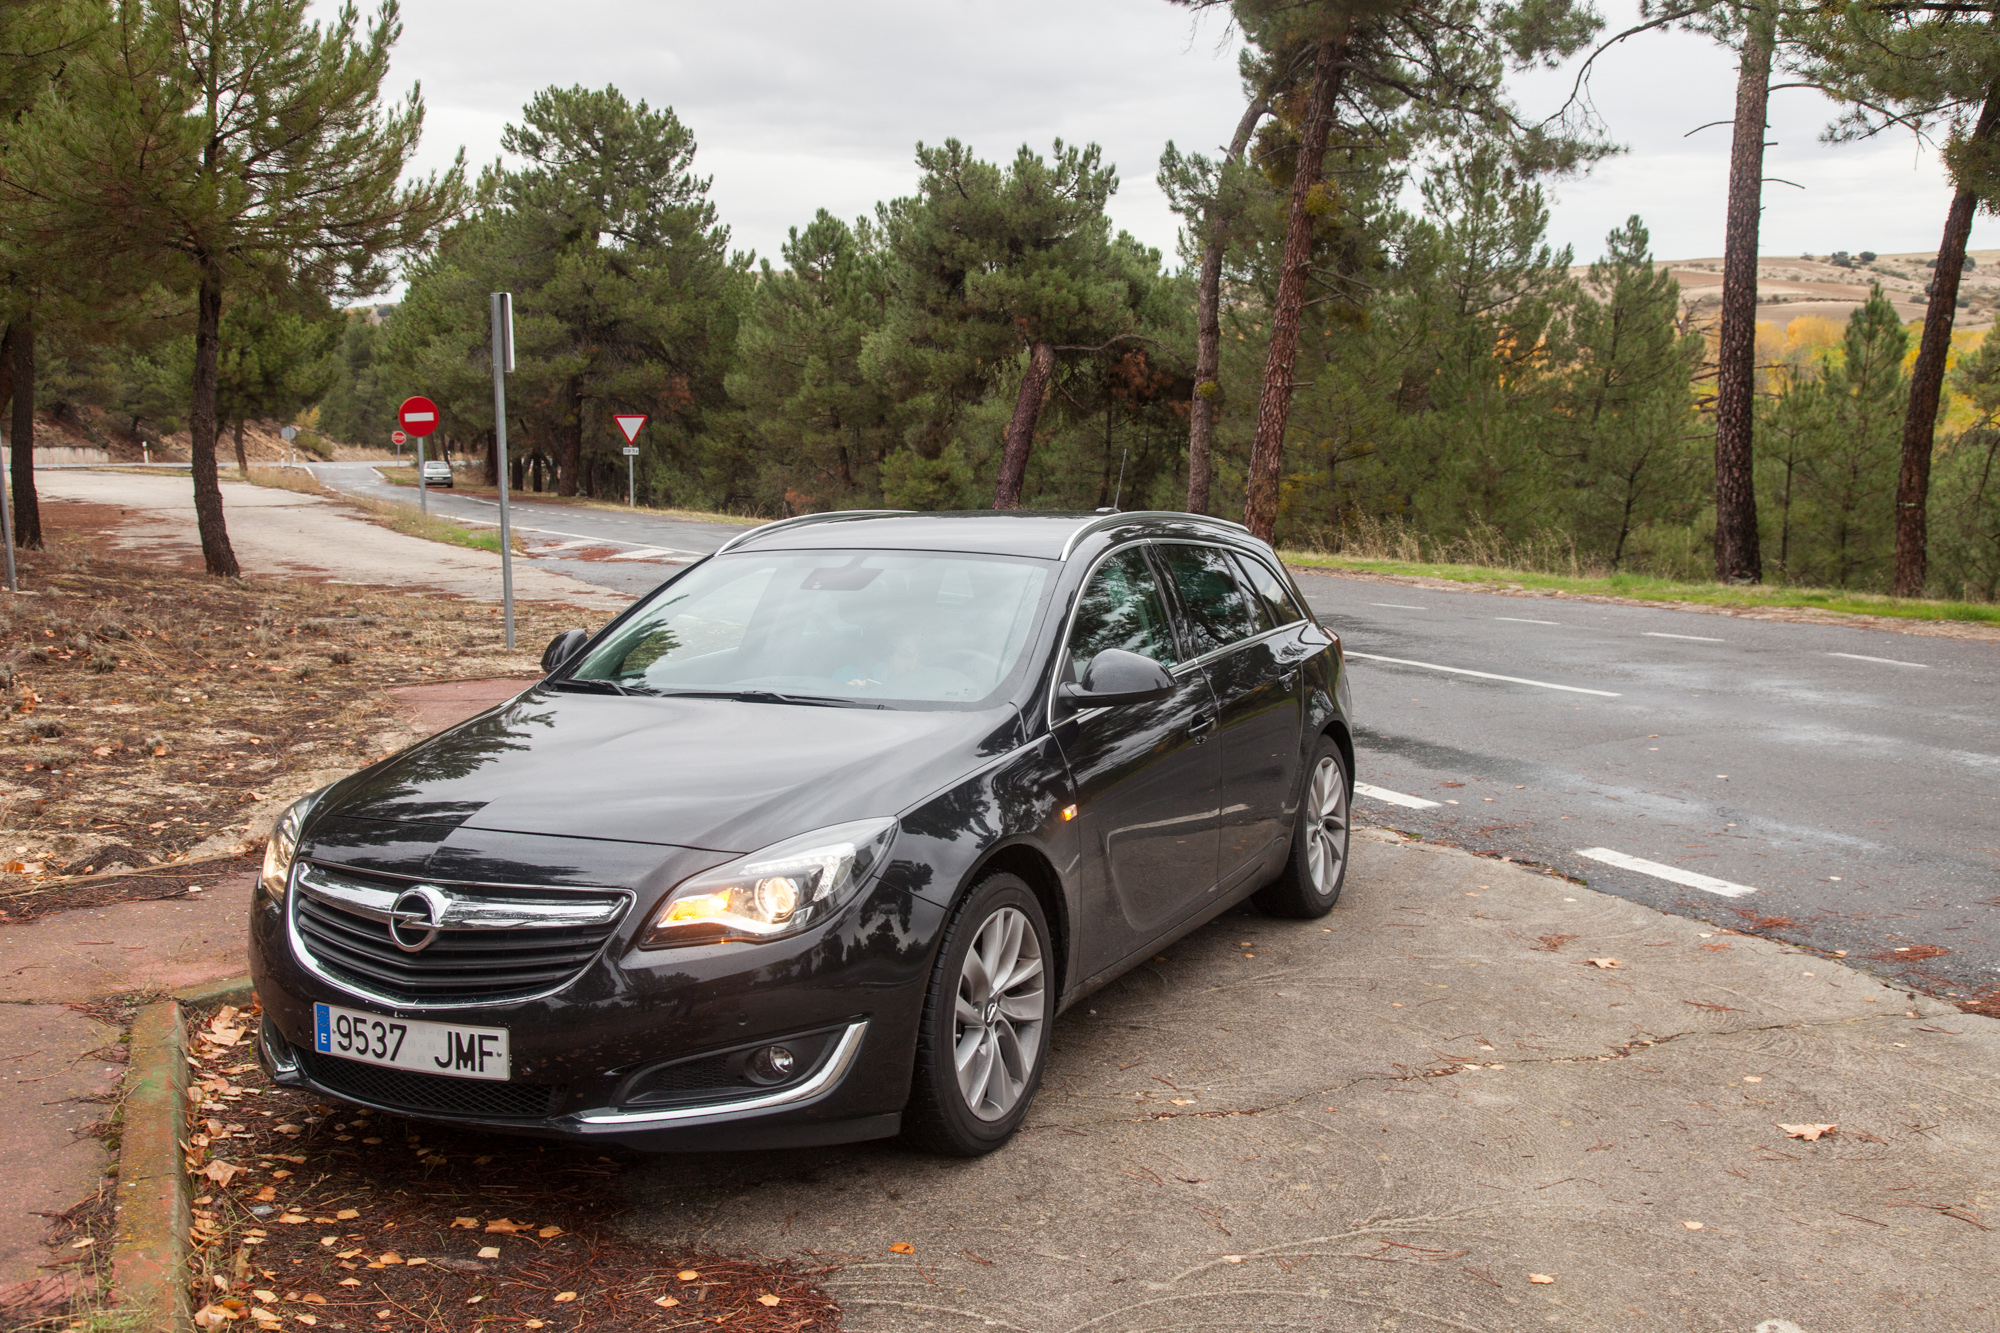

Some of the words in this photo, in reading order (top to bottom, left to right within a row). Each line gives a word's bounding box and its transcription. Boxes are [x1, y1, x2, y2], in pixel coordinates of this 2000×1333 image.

[321, 1033, 327, 1044] E
[336, 1014, 408, 1062] 9537
[434, 1031, 499, 1072] JMF
